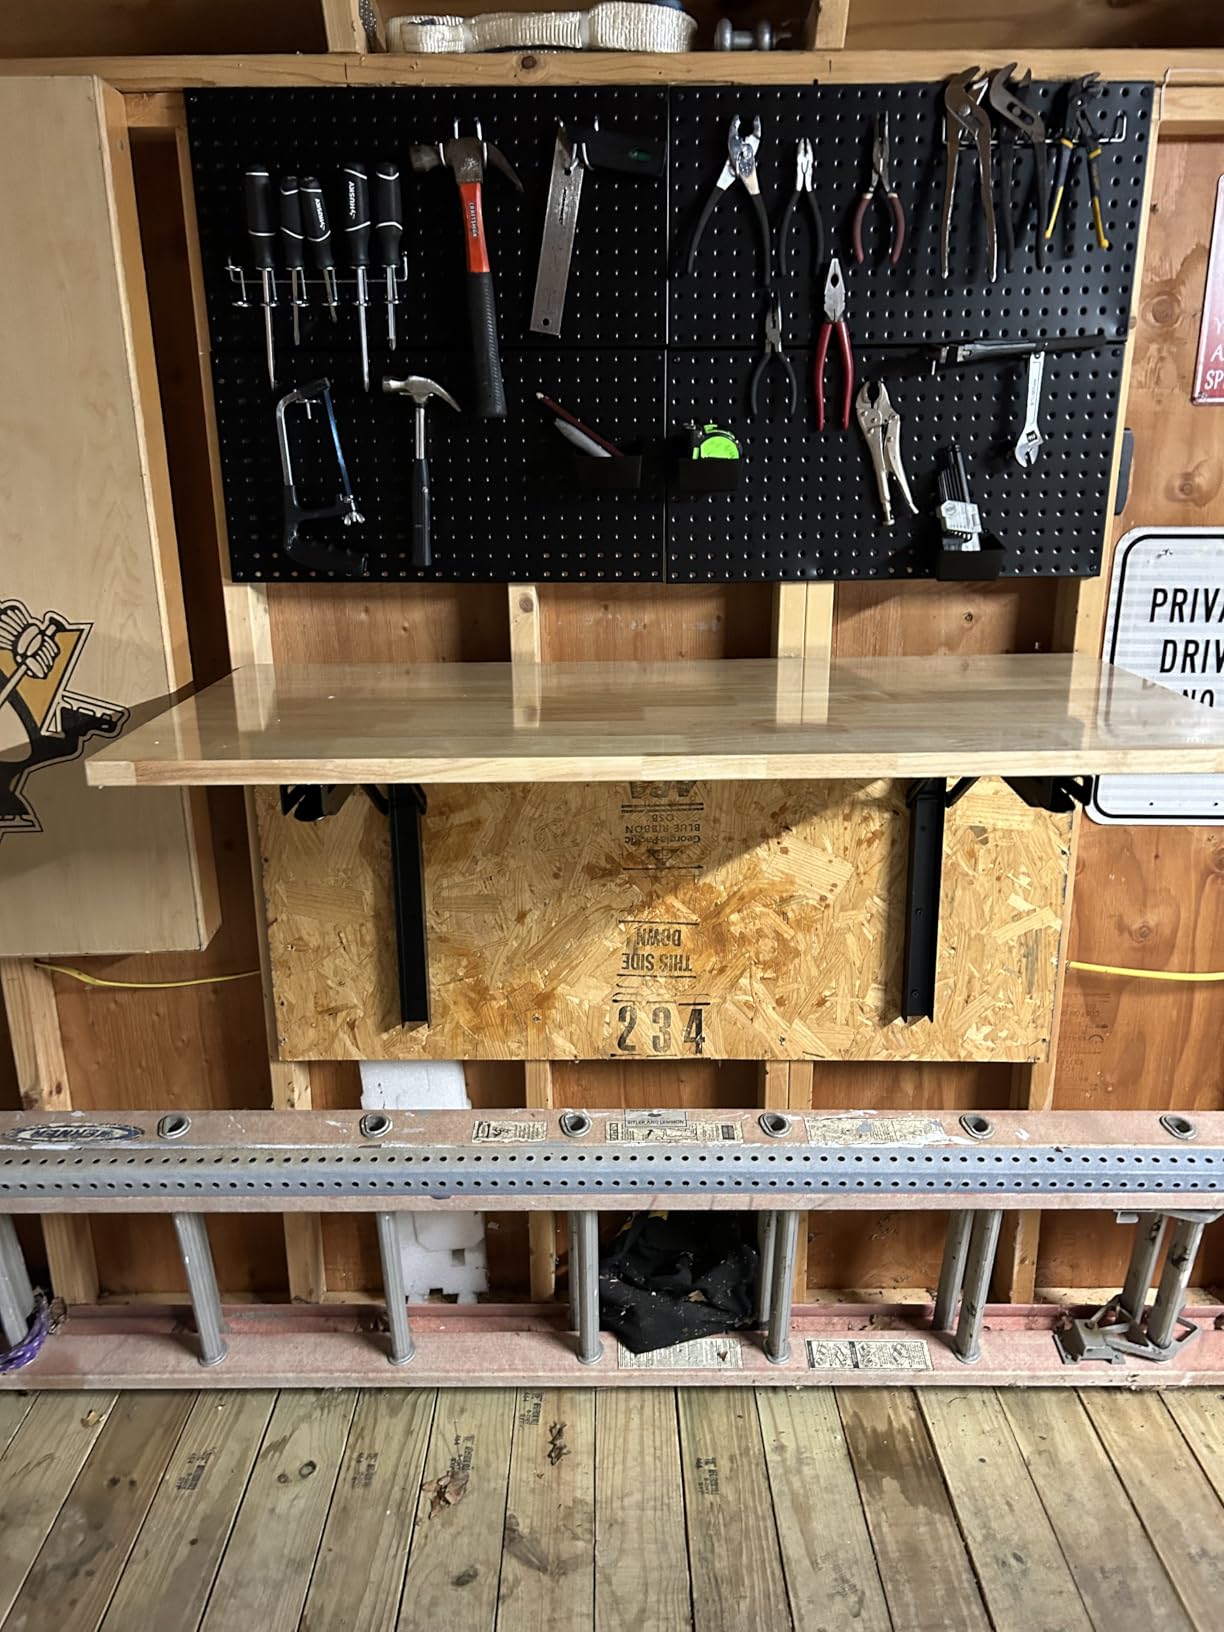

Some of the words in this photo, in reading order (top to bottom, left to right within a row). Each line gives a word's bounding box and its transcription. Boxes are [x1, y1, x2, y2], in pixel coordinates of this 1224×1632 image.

[348, 181, 356, 211] HUSKY
[1204, 369, 1224, 390] SP
[1149, 587, 1224, 623] PRIV
[624, 824, 669, 834] RIBBON
[673, 823, 701, 832] BLUE
[636, 927, 682, 947] DOWN
[621, 953, 655, 971] SIDE
[659, 954, 692, 972] THIS
